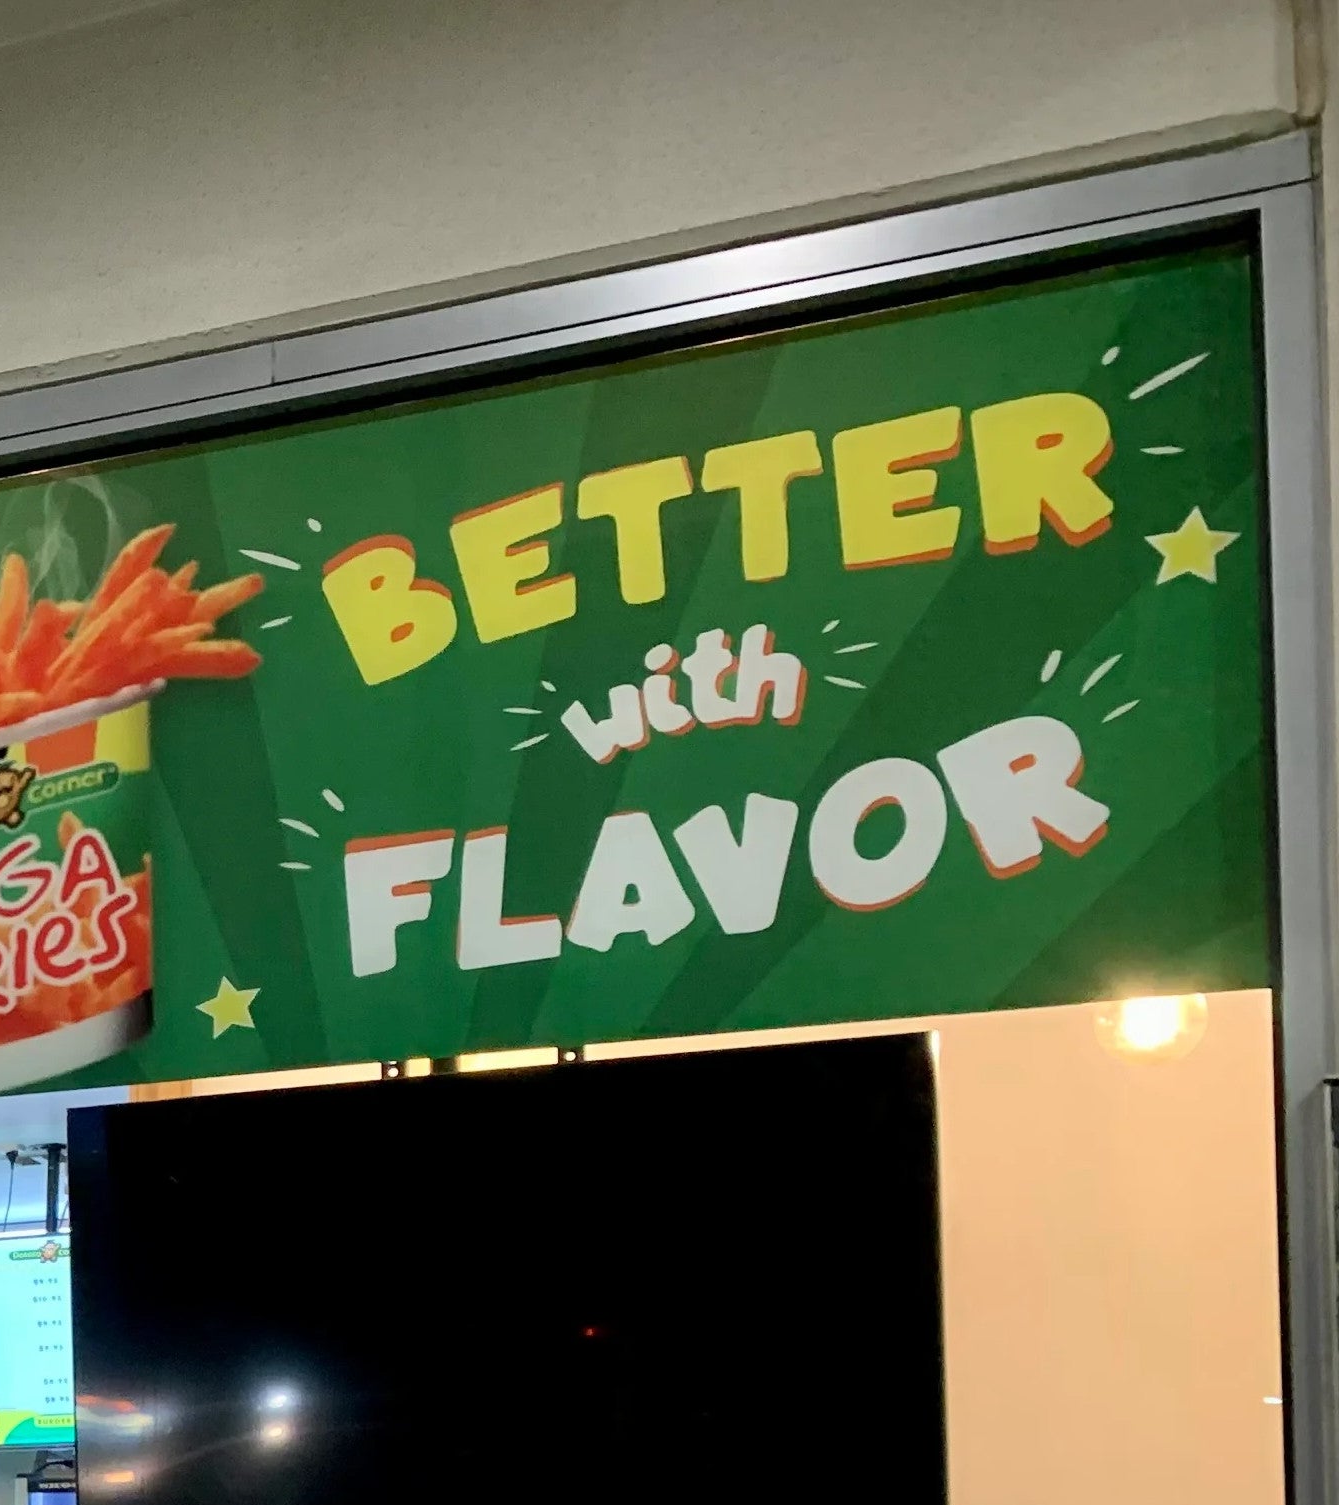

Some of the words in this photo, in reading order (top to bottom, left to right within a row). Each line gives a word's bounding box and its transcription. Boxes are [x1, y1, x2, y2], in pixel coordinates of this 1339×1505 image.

[321, 391, 1116, 686] BETTER
[561, 623, 807, 764] with
[344, 715, 1111, 978] FLAVOR
